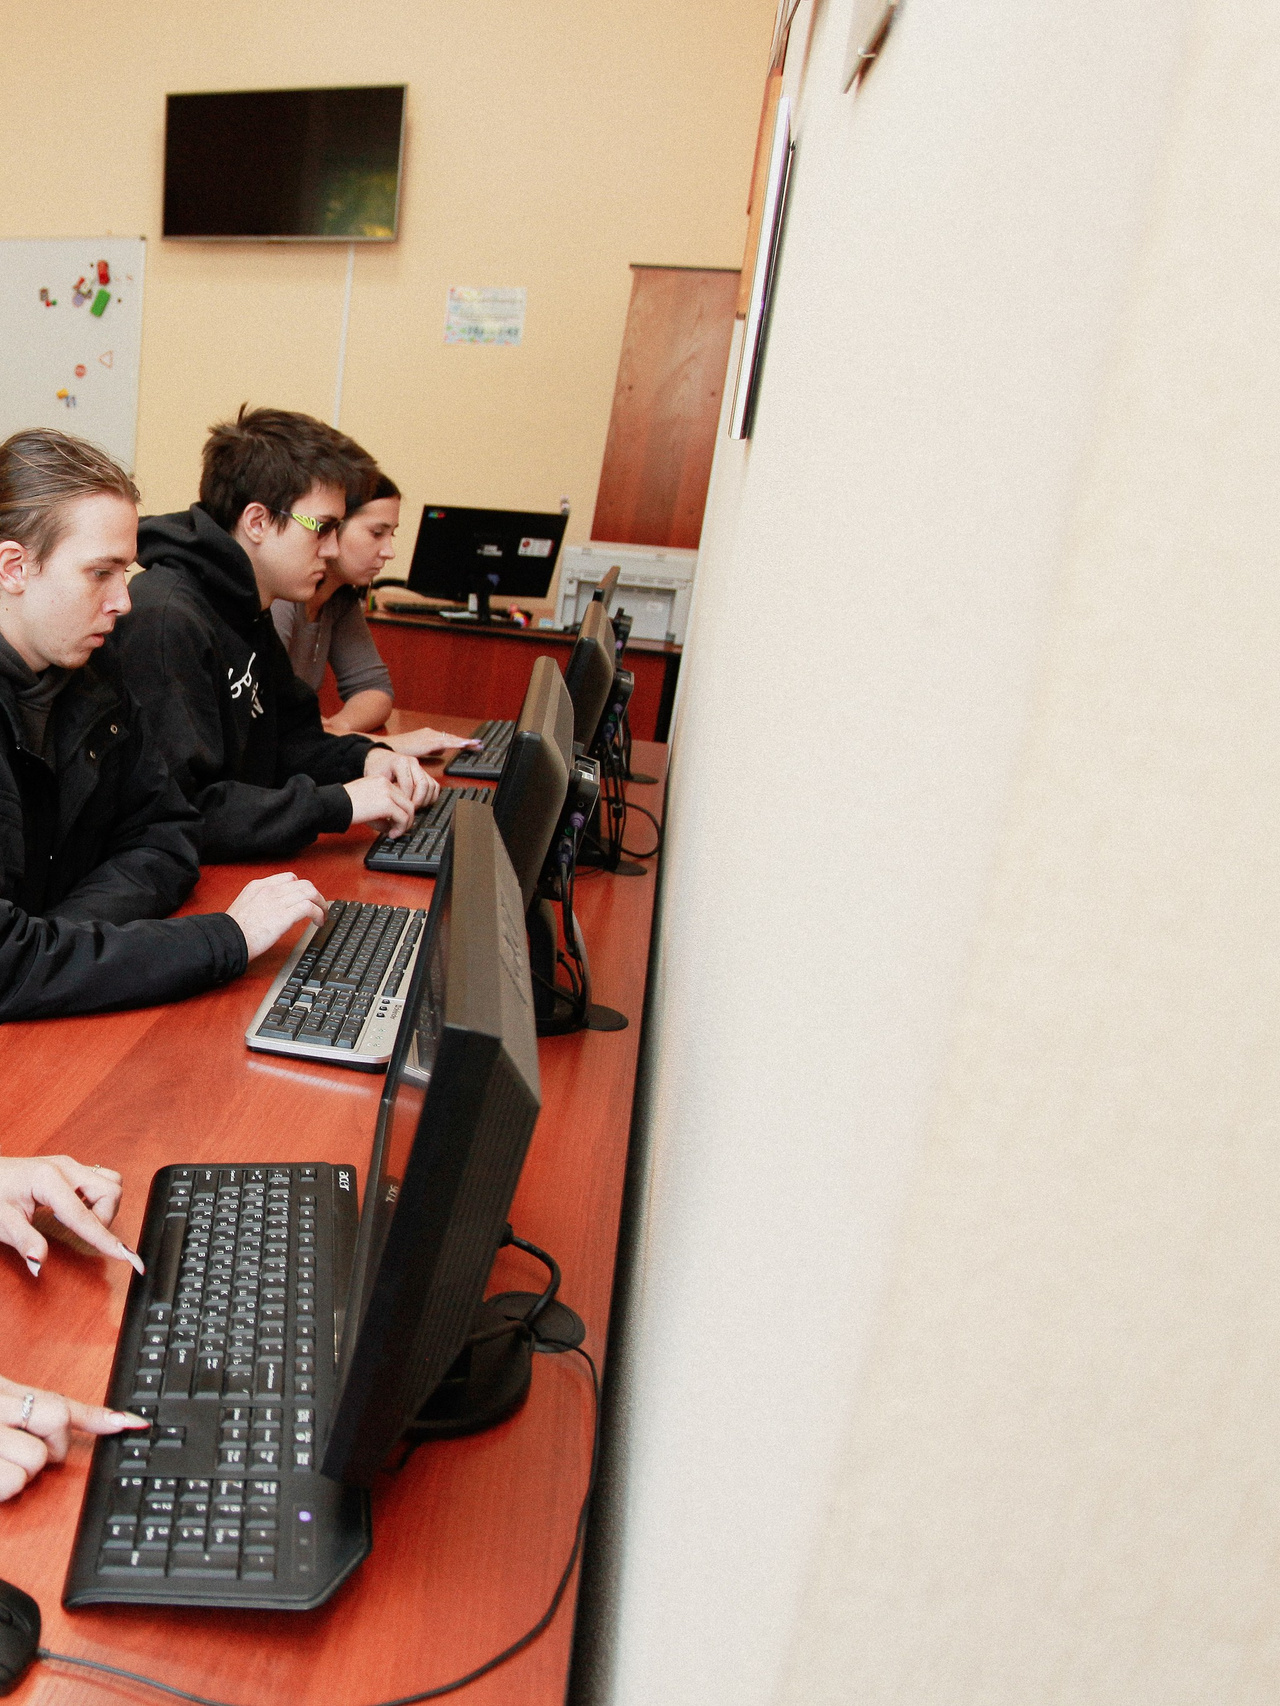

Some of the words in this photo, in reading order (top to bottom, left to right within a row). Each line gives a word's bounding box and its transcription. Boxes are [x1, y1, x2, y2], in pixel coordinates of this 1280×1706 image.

[338, 1170, 350, 1192] acer
[233, 1481, 242, 1489] 7
[162, 1502, 172, 1510] 2
[158, 1527, 169, 1535] 3
[193, 1528, 204, 1536] 6
[228, 1529, 239, 1537] 9
